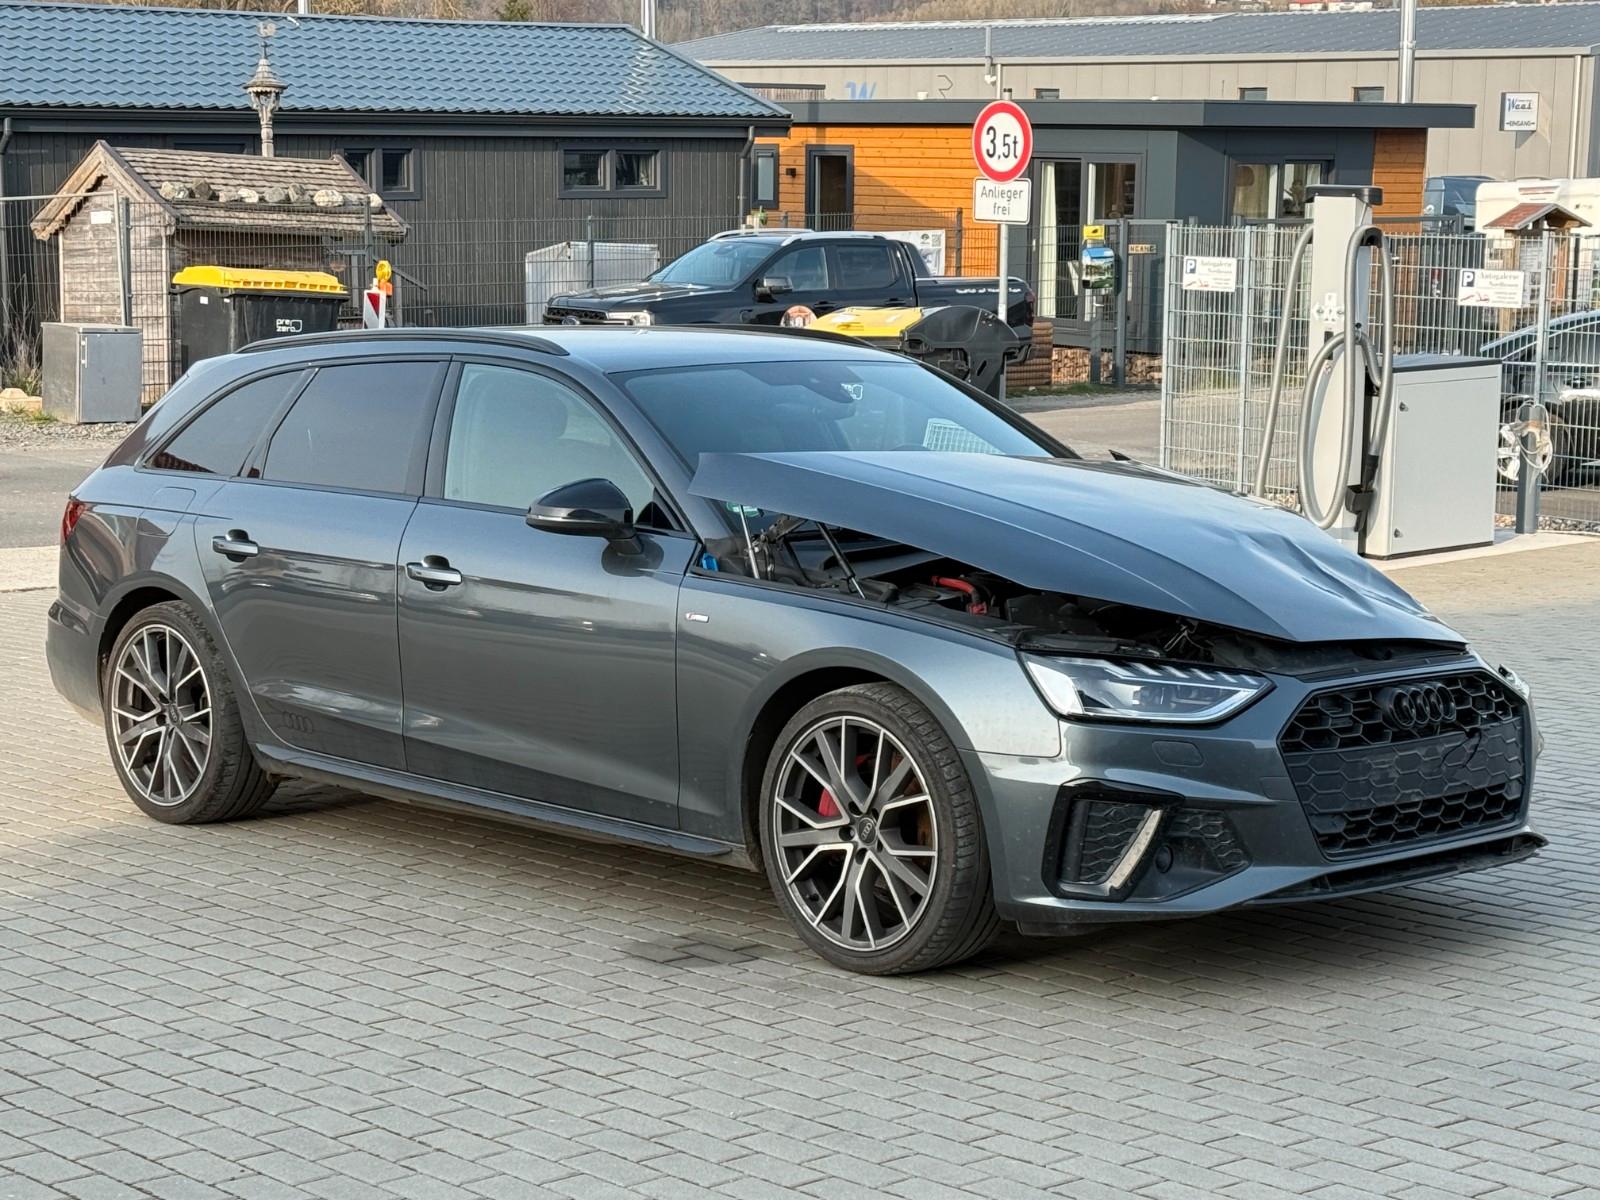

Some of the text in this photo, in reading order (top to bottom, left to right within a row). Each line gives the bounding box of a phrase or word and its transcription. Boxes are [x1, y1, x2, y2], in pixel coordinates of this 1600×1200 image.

[980, 185, 1023, 202] Anlieger
[993, 202, 1011, 215] frei
[1186, 259, 1196, 273] P
[1462, 271, 1474, 287] P
